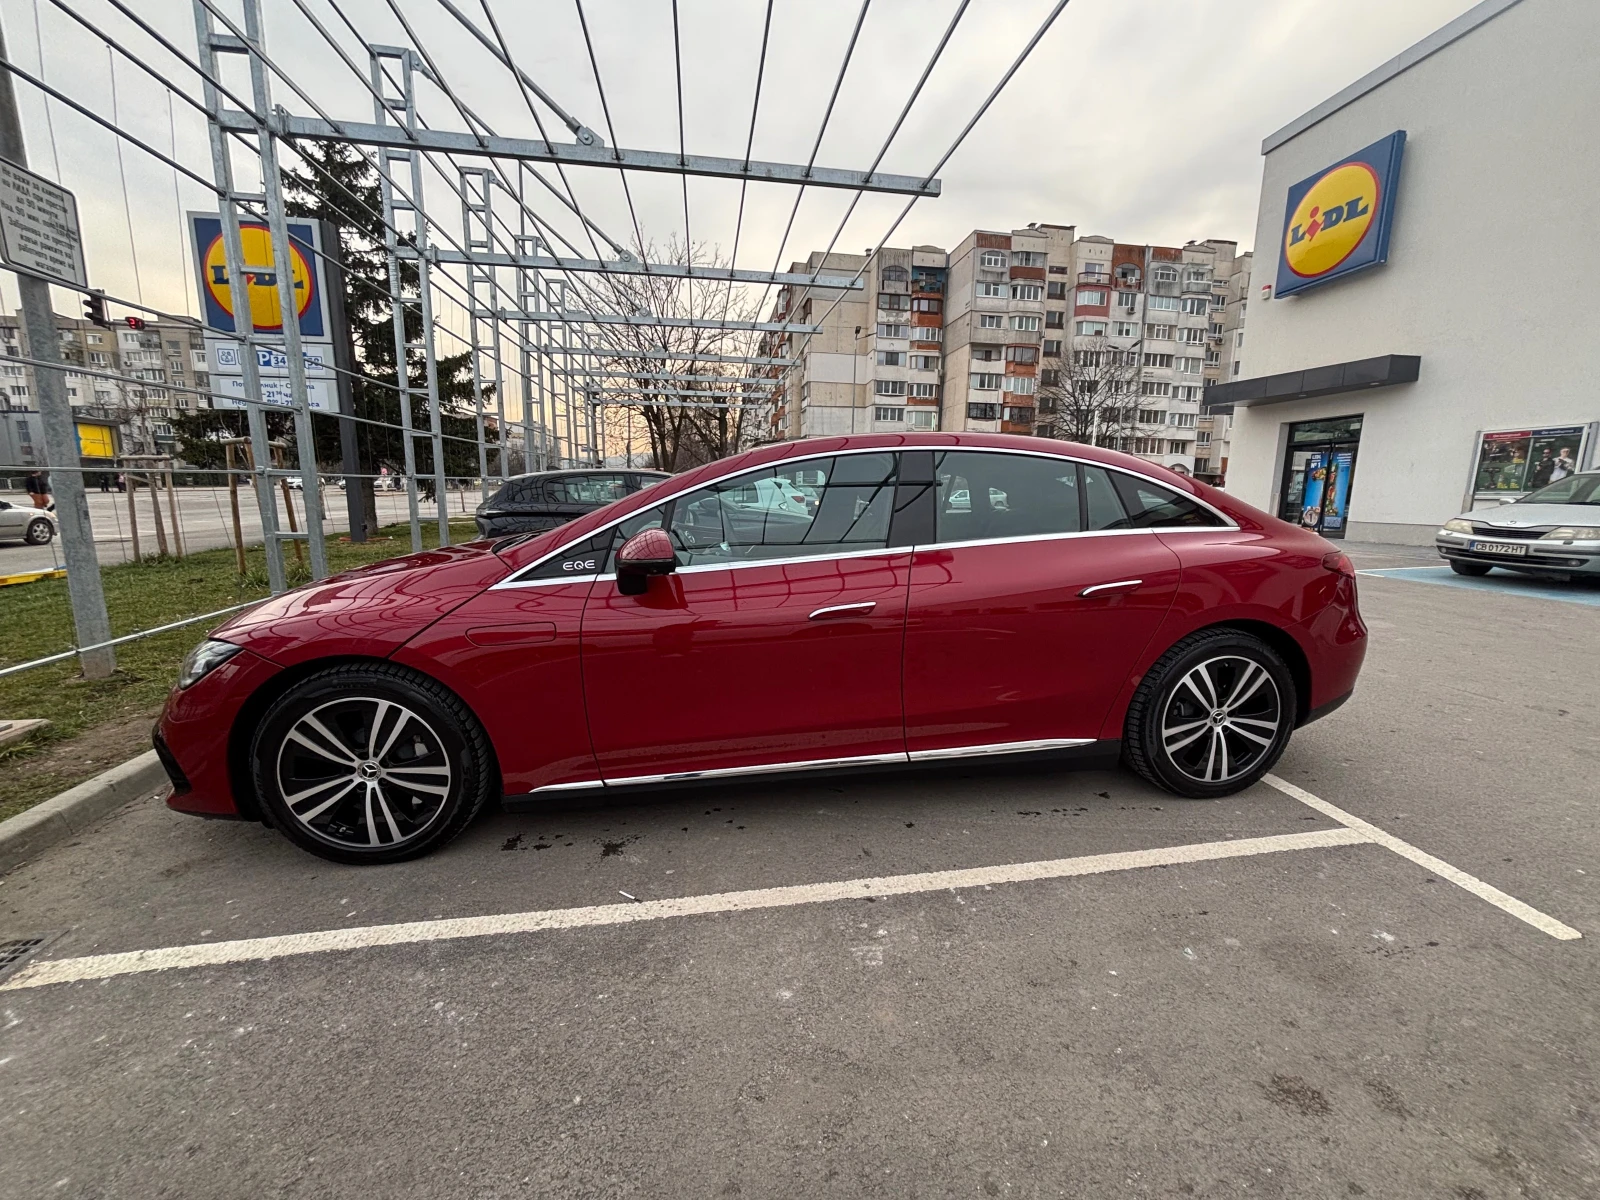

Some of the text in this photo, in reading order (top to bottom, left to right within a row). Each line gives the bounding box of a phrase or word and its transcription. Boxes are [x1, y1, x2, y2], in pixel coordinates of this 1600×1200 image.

[258, 352, 287, 365] P 34
[1475, 543, 1487, 551] CB
[1488, 545, 1510, 553] 0172
[563, 560, 595, 570] EQE
